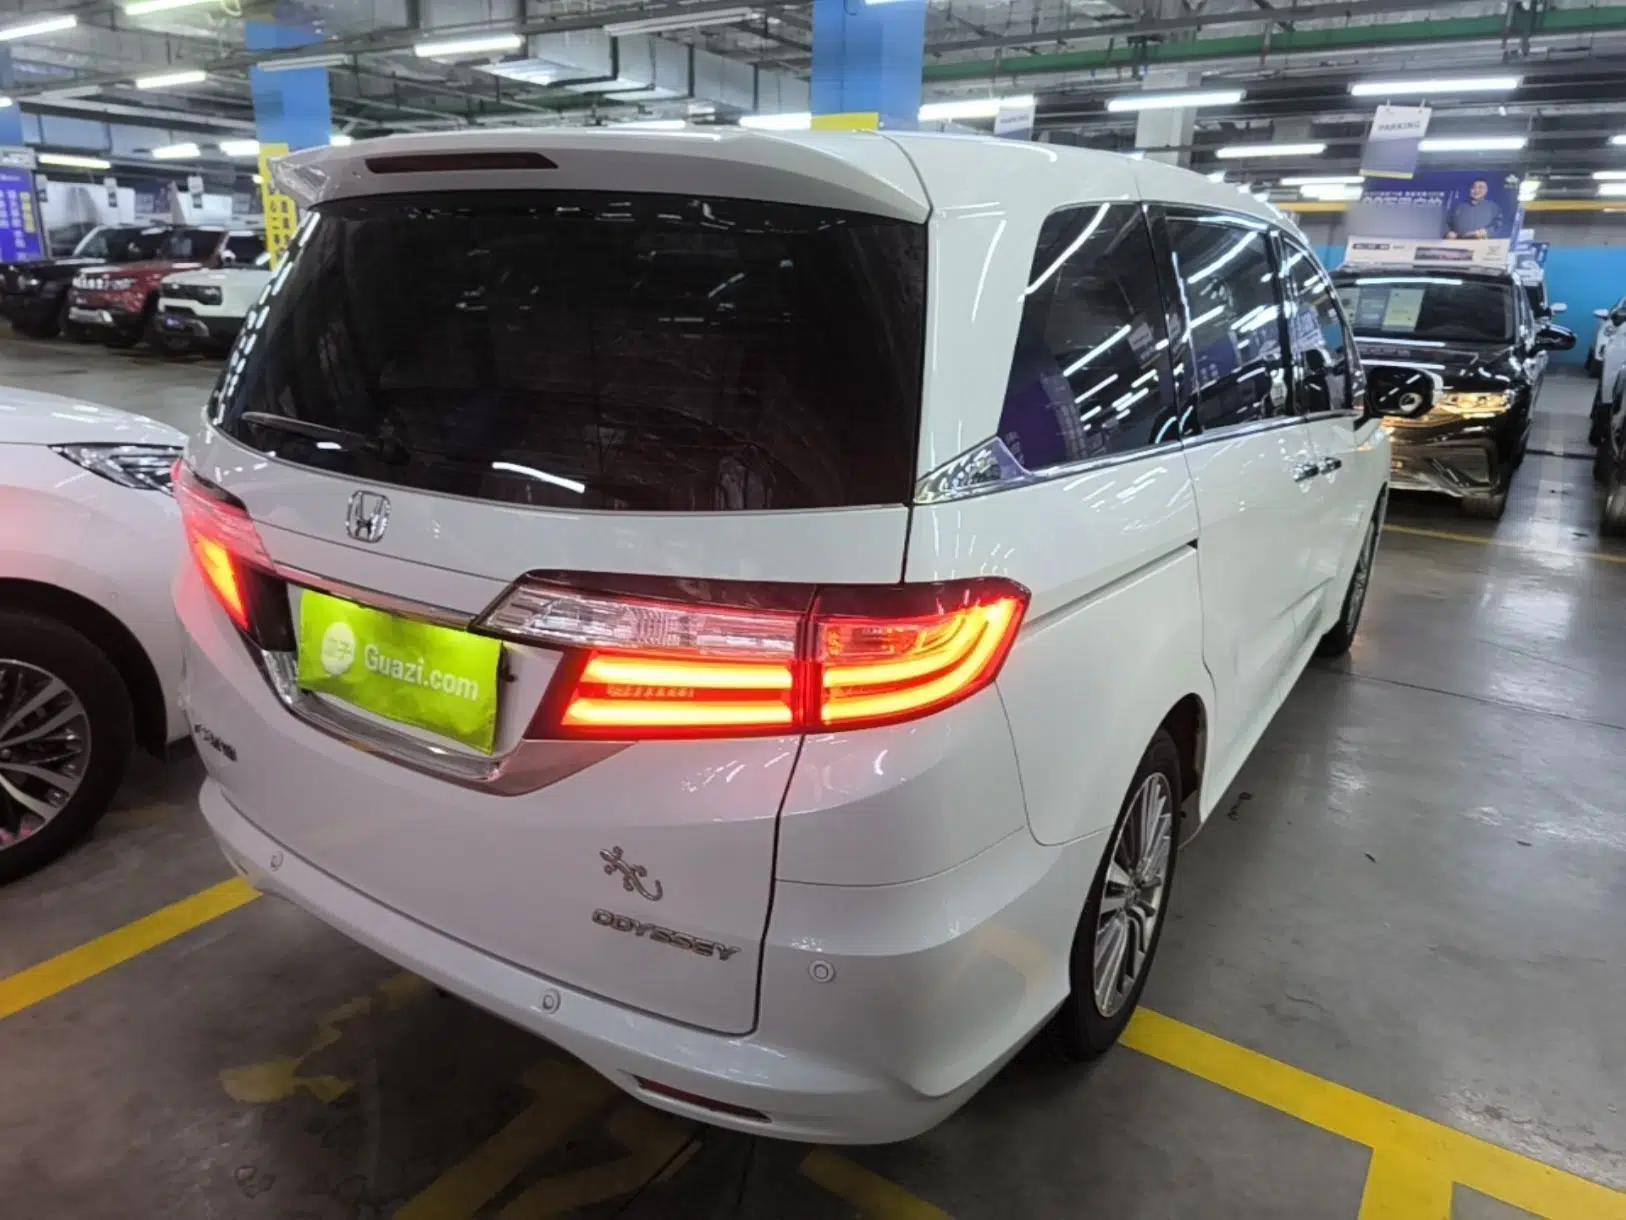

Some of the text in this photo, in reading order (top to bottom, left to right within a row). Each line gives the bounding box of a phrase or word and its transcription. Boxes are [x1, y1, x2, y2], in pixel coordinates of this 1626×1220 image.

[1378, 121, 1421, 131] PARKING
[363, 644, 480, 702] Guazi.com
[592, 908, 742, 962] ODYSSEY
